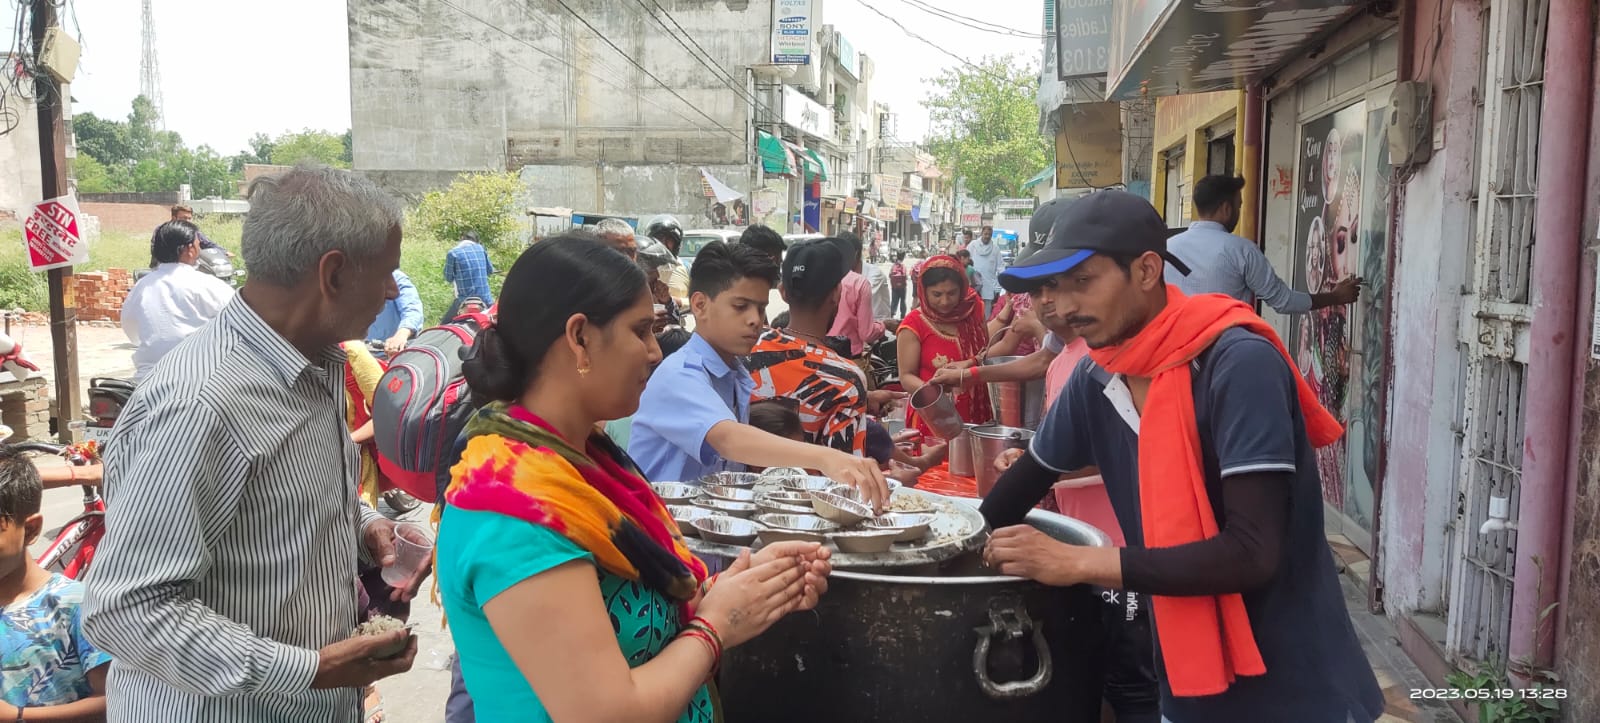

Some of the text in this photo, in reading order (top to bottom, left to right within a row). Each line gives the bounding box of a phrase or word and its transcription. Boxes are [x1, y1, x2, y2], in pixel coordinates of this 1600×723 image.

[47, 203, 74, 229] STN
[25, 216, 53, 245] FREE
[96, 429, 109, 437] UK
